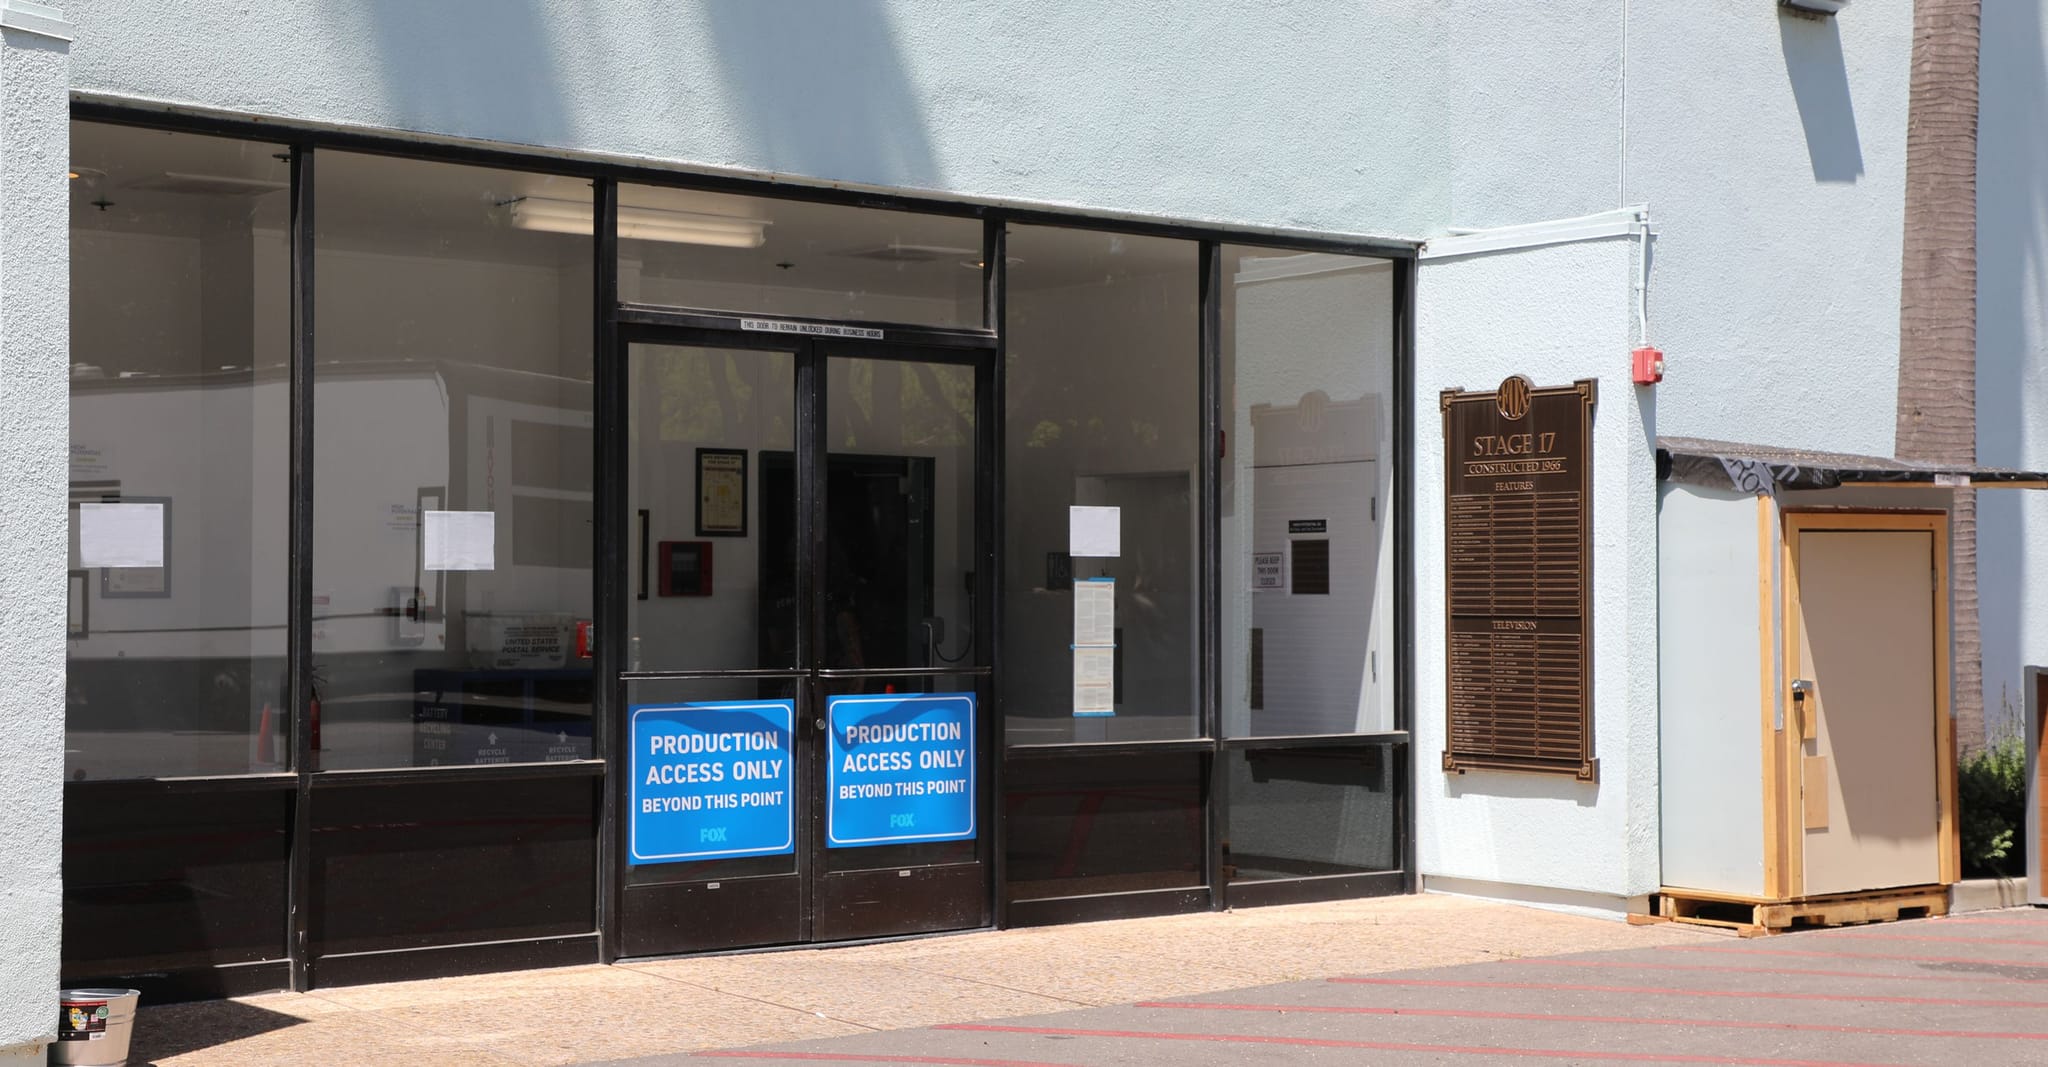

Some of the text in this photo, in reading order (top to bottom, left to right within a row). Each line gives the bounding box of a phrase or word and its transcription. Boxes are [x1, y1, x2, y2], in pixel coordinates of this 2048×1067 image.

[743, 321, 881, 338] THIS DOOR TO REMAIN UNLOCKED DURING BUSINESS HOURS
[1500, 377, 1529, 418] FOX
[1473, 432, 1556, 457] STAGE 17
[1469, 460, 1561, 474] CONSTRUCTED 1966
[1495, 481, 1534, 491] FEATURES
[1492, 620, 1537, 630] TELEVISION
[531, 645, 560, 653] SERVICE
[846, 722, 961, 744] PRODUCTION
[478, 748, 506, 757] RECYCLE
[650, 731, 778, 755] PRODUCTION
[842, 749, 965, 773] ACCESS ONLY
[646, 760, 783, 785] ACCESS ONLY
[839, 779, 967, 800] BEYOND THIS POINT
[642, 791, 784, 813] BEYOND THIS POINT
[890, 813, 915, 828] FOX
[700, 827, 727, 843] FOX
